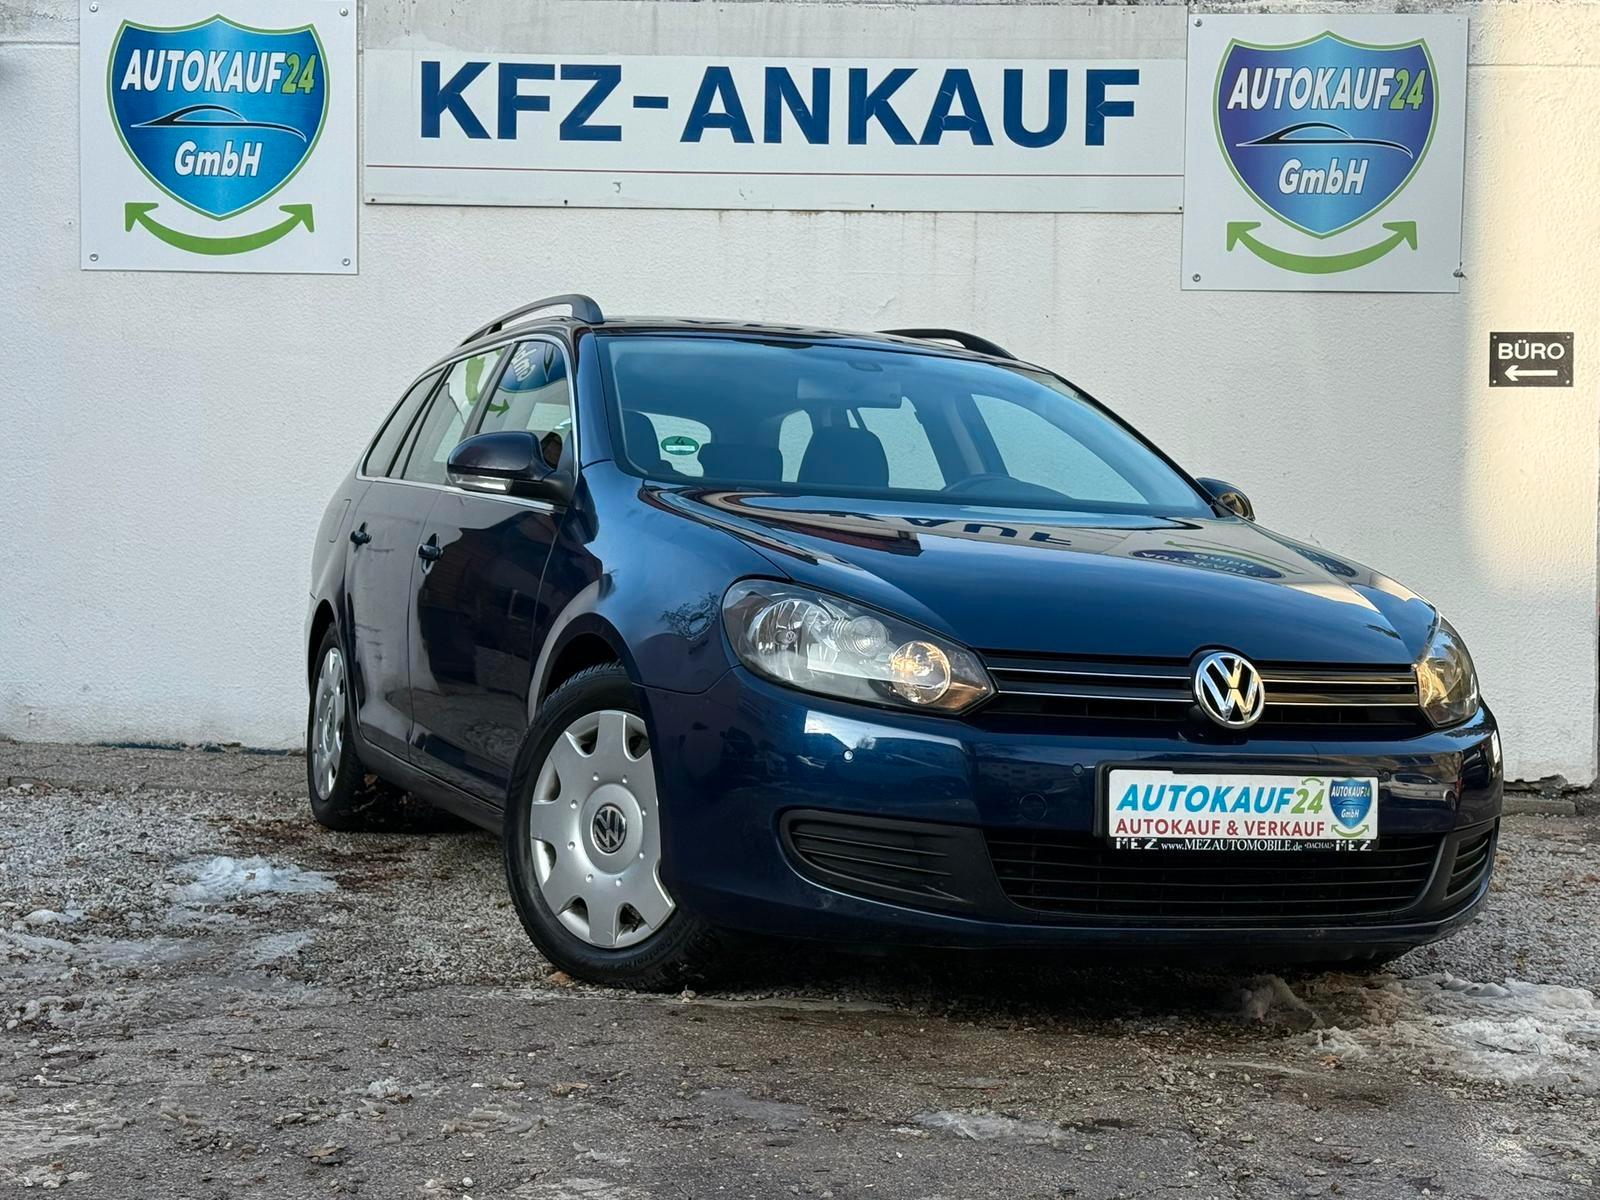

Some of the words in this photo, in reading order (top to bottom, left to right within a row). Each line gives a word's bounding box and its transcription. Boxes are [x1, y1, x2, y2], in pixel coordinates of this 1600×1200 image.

[121, 49, 317, 94] AUTOKAUF24
[420, 60, 1140, 148] KFZ-ANKAUF
[1227, 67, 1427, 110] AUTOKAUF24
[174, 140, 264, 177] GmbH
[1278, 158, 1369, 195] GmbH
[1498, 339, 1565, 360] BÜRO
[1116, 784, 1325, 815] AUTOKAUF24
[1331, 785, 1371, 798] AUTOKAUF24
[1115, 818, 1221, 836] AUTOKAUF
[1226, 820, 1239, 836] &
[1244, 820, 1325, 837] VERKAUF
[1341, 808, 1360, 818] GmbH
[1116, 837, 1159, 850] MEZ
[1161, 838, 1302, 852] www.MEZAUTOMOBILE.de
[1336, 840, 1373, 852] MEZ
